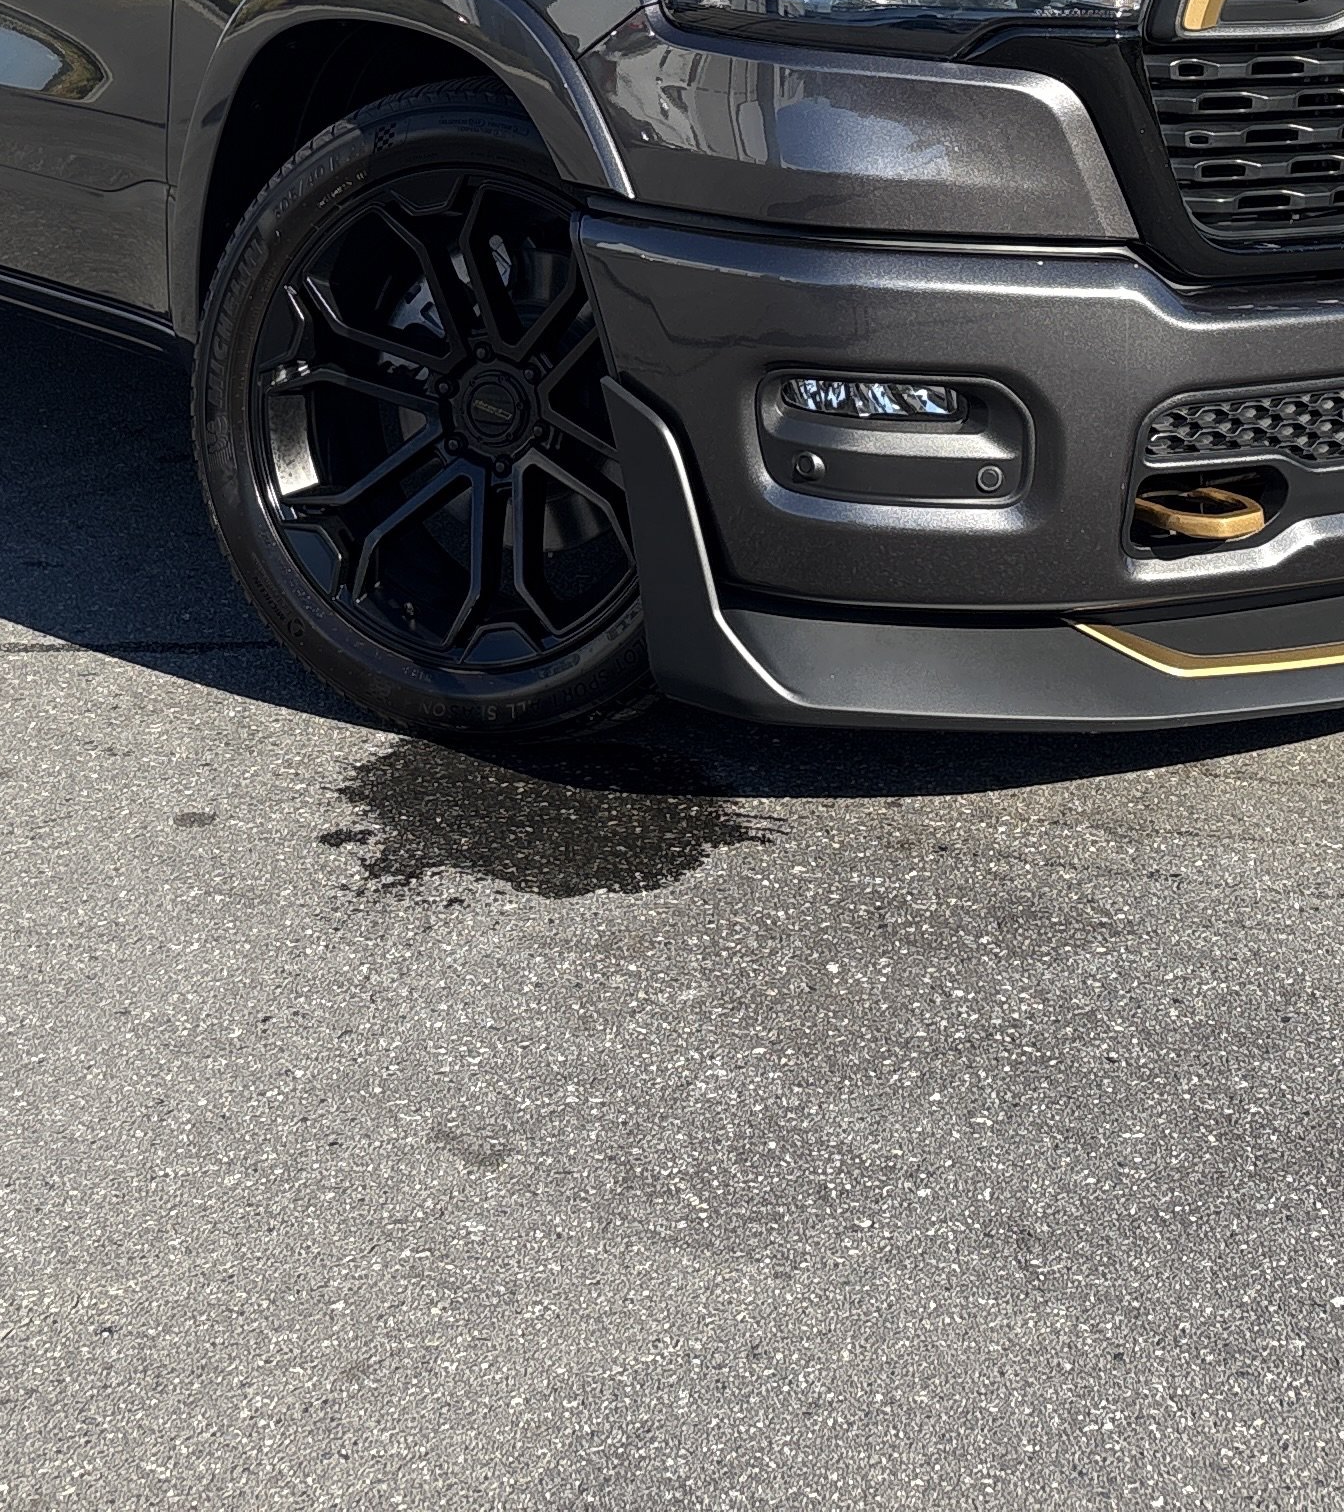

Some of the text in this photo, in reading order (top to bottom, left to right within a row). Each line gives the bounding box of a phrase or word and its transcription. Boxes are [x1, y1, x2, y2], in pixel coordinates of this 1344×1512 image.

[206, 233, 267, 409] MICHELIN
[550, 670, 607, 708] SPORT
[419, 701, 497, 721] SEASON
[505, 697, 541, 719] ALL
